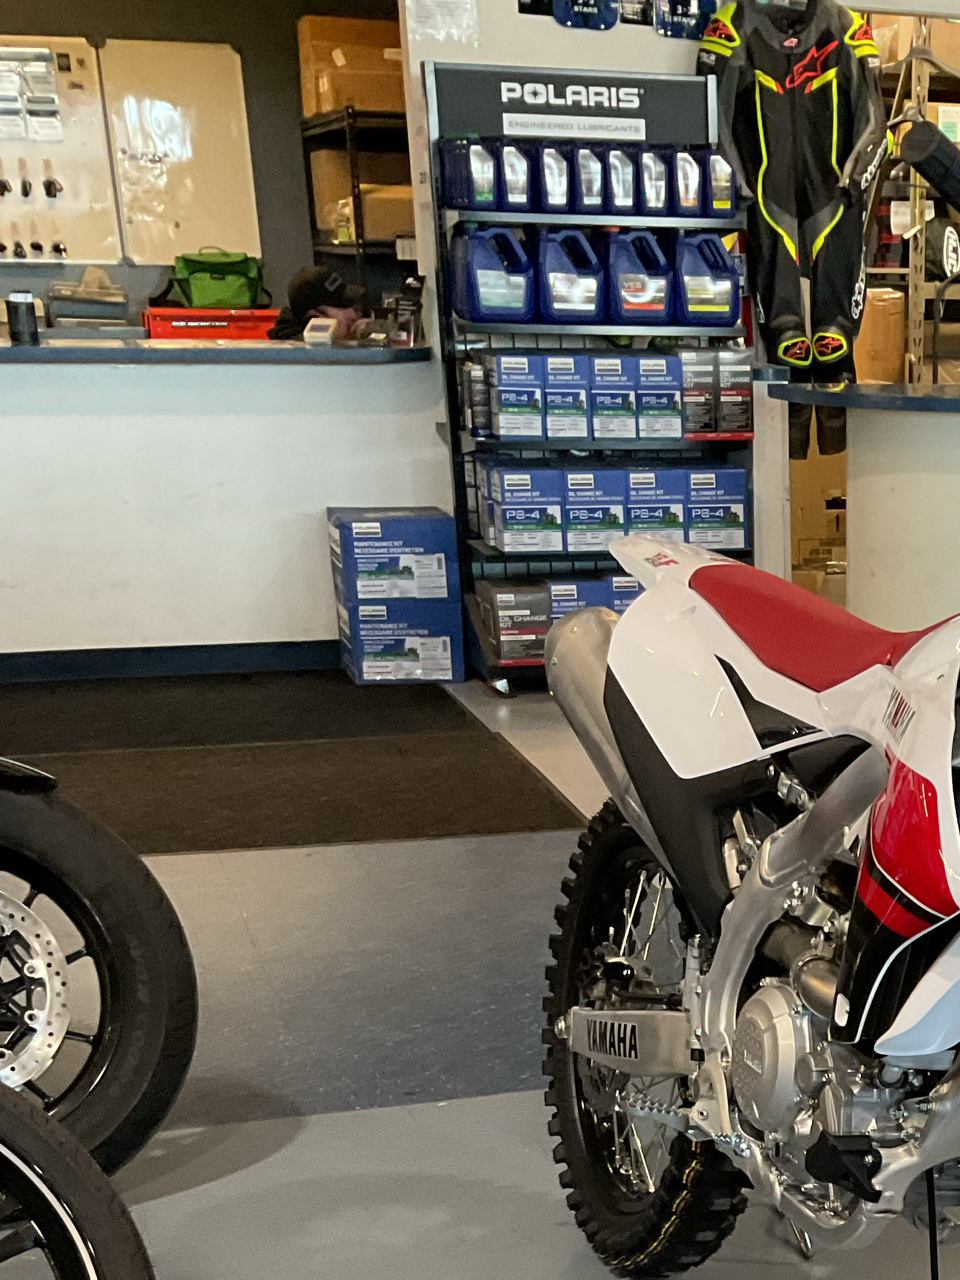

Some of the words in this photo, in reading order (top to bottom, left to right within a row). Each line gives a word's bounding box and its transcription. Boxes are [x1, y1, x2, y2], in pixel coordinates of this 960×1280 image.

[500, 82, 640, 108] POLARIS
[508, 120, 574, 130] ENGINEERED
[578, 123, 641, 134] LUBRICANTS
[506, 510, 540, 519] PS-4
[570, 510, 603, 519] PS-4
[631, 509, 663, 518] PS-4
[692, 509, 724, 518] PS-4
[586, 1018, 639, 1060] YAMAHA
